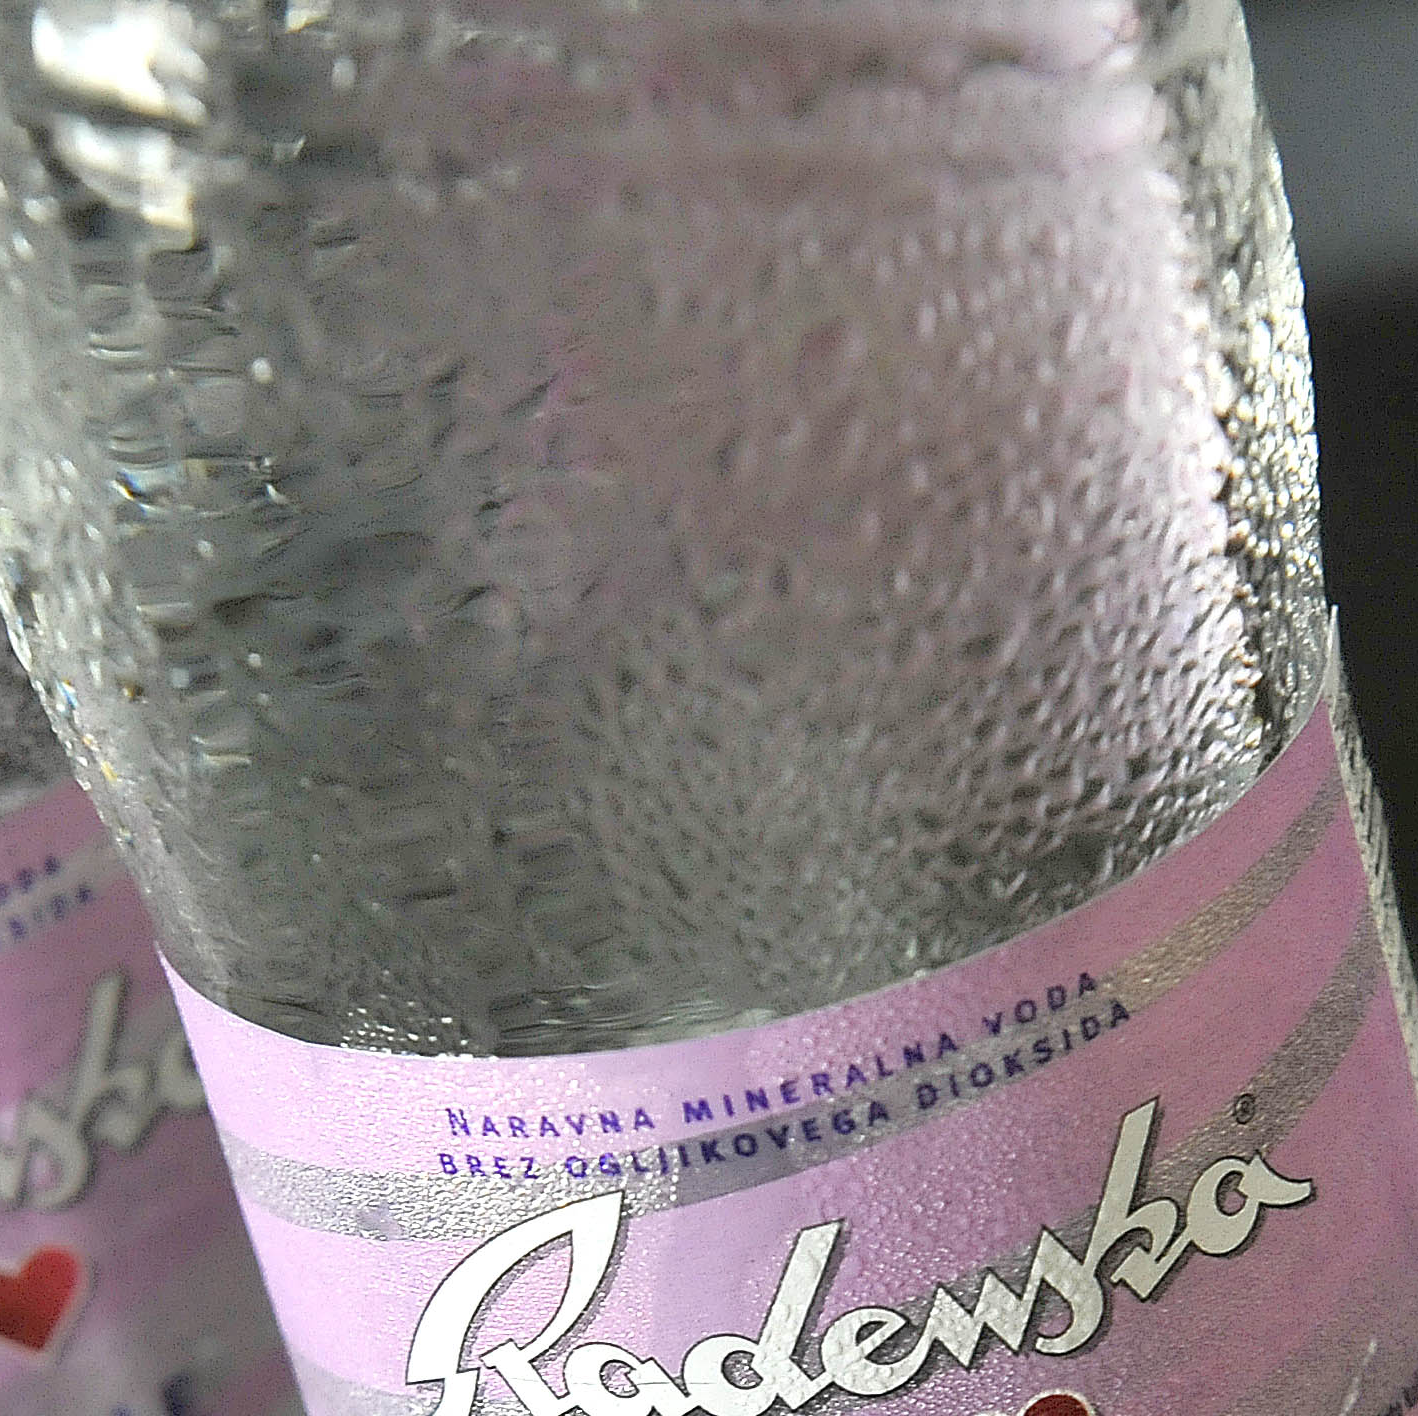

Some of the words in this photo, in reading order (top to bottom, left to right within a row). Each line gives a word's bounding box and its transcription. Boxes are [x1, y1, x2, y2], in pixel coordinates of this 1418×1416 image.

[439, 1153, 540, 1180] BREZ
[564, 1101, 892, 1179] OGLJIKOVEGA
[917, 999, 1134, 1110] DIOKSIDA
[446, 1108, 655, 1139] NARAVNA
[682, 1032, 960, 1124] MINERALNA
[981, 970, 1099, 1039] VODA
